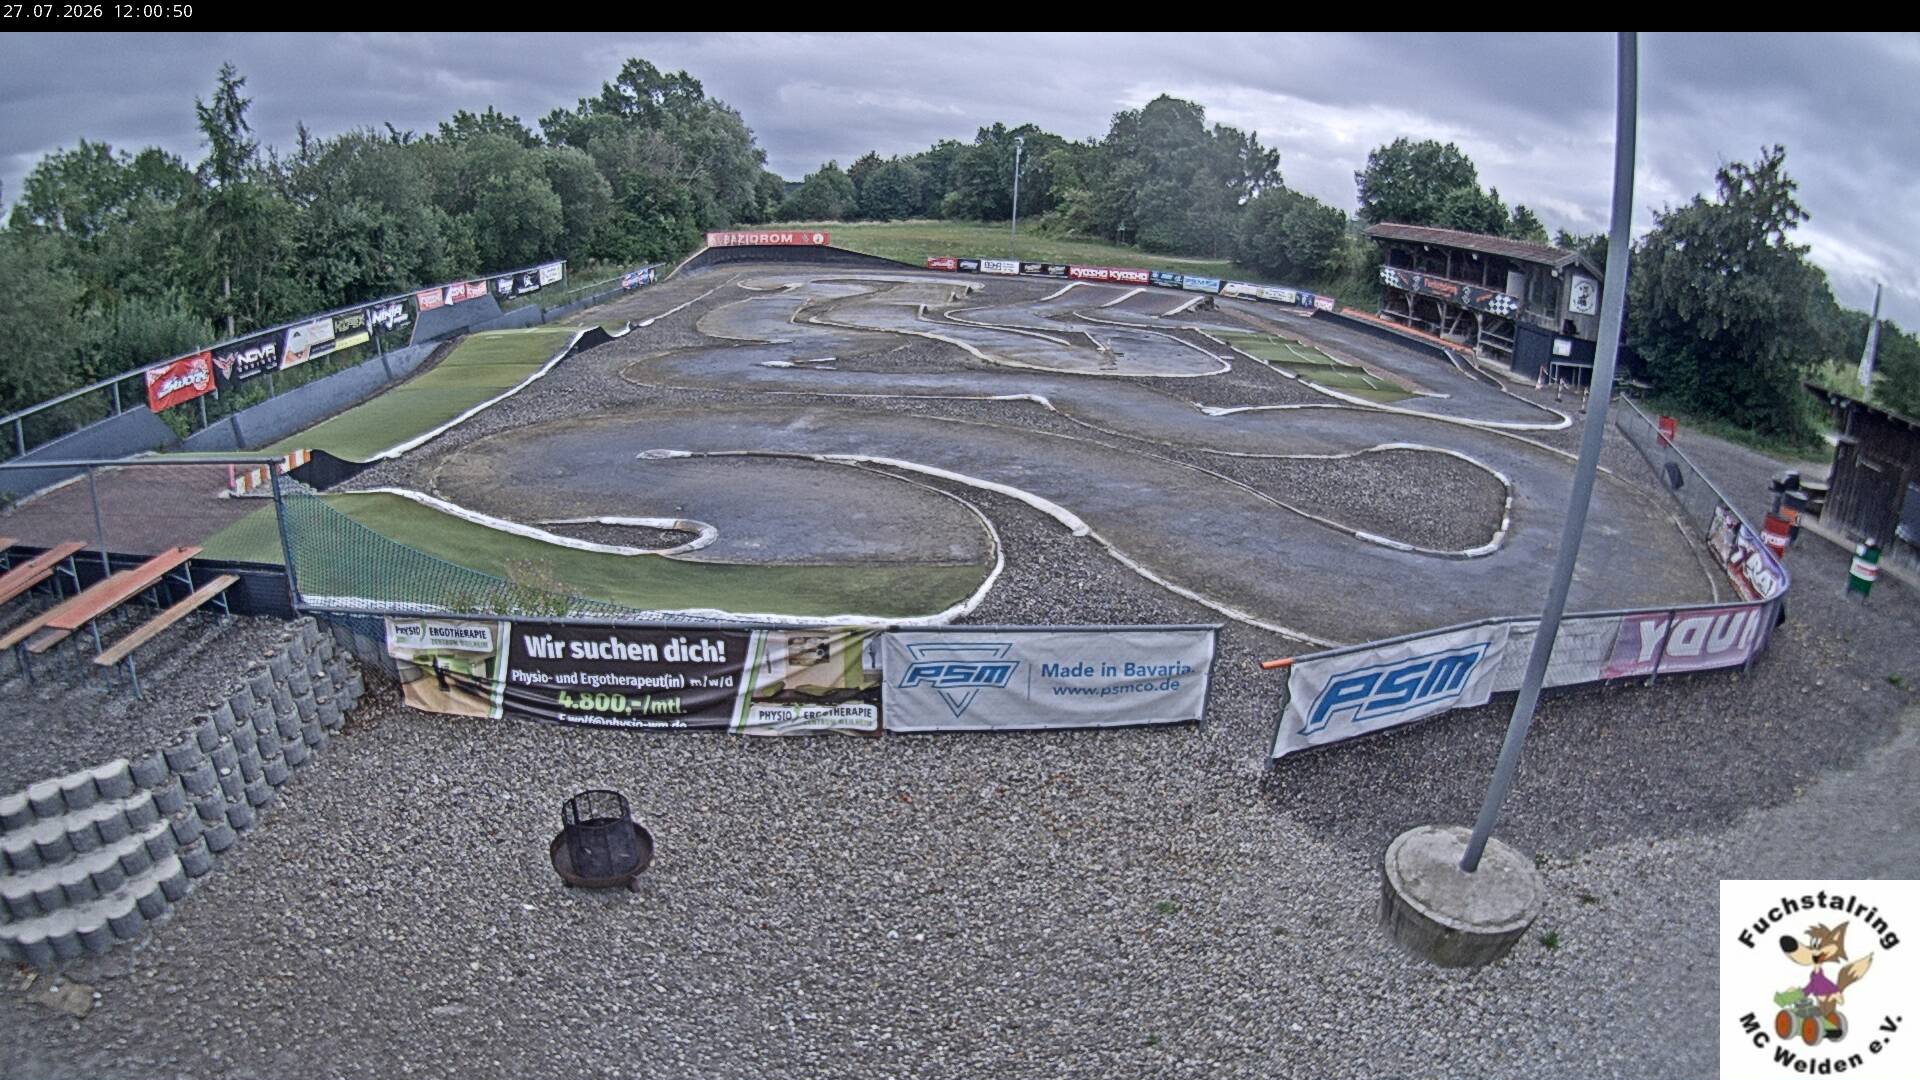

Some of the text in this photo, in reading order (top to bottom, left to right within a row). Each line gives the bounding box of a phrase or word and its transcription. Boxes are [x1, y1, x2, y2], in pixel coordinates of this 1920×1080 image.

[395, 625, 488, 639] PHYSIO ERGOTHERAPIE
[523, 633, 727, 662] Wir suchen dich!
[511, 669, 734, 689] Physio- und Ergotherapeut(in) m/w/d
[907, 663, 1012, 685] PSM
[1041, 661, 1094, 678] Made
[1101, 662, 1117, 677] in
[1052, 678, 1180, 697] www.psmco.de
[1309, 650, 1482, 726] PSM
[759, 710, 793, 721] PHYSIO
